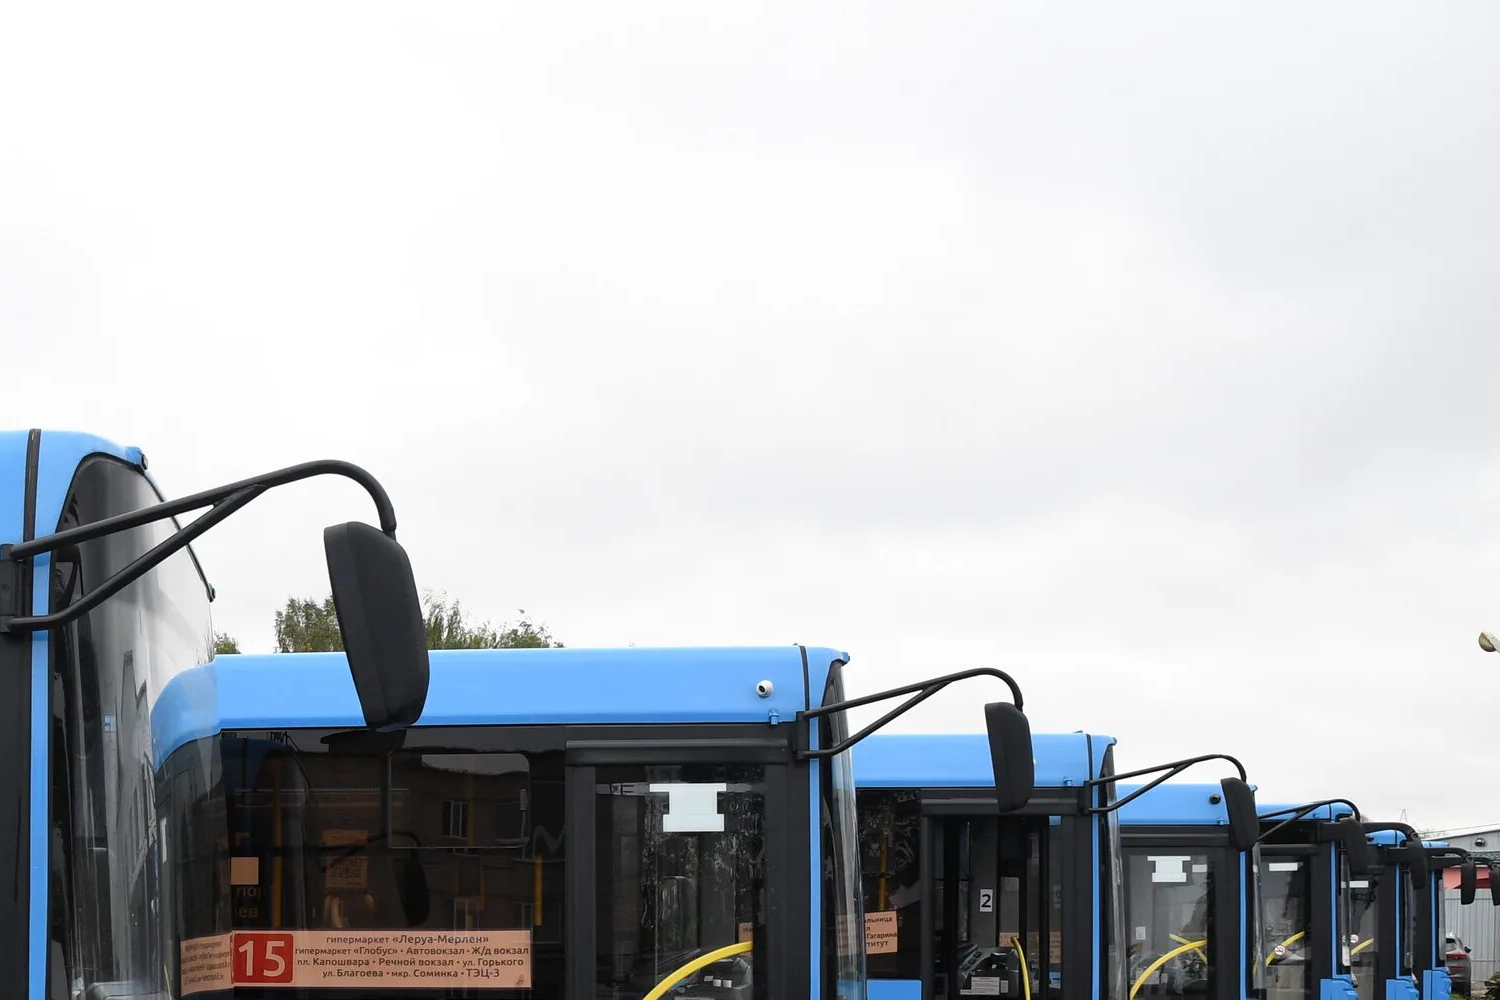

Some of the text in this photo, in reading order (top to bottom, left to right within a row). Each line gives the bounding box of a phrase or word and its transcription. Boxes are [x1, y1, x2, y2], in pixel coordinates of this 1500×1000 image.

[981, 893, 991, 908] 2
[326, 934, 489, 949] гипермаркет «Леруа-Мерлен»
[295, 945, 529, 957] гипермаркет «Глобус» Автовокзал Ж/д вокзал
[238, 940, 286, 978] 15
[312, 957, 370, 968] Капошвара
[378, 957, 416, 966] Речной
[418, 959, 454, 967] вокзал
[462, 960, 476, 968] ул.
[477, 957, 524, 968] Горького
[322, 968, 500, 980] ул. Благоева мкр. Соминка ТЭЦ-3
